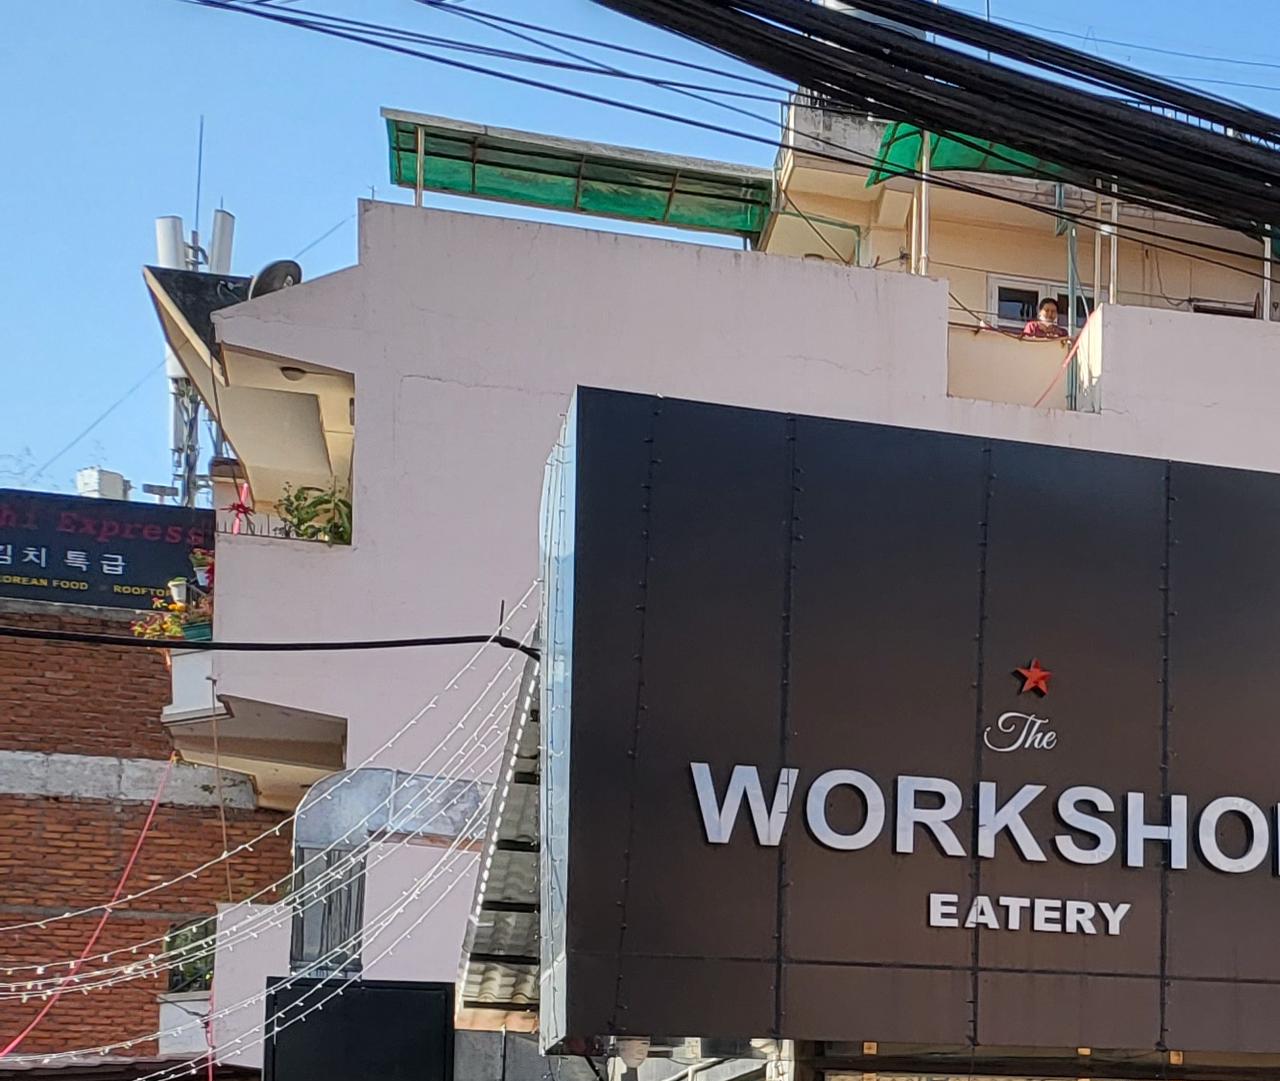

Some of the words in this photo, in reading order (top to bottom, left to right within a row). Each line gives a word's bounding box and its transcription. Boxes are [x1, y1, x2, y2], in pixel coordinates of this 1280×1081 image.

[56, 511, 206, 545] Express
[64, 550, 126, 575] 특급
[0, 575, 48, 587] OREAN
[52, 579, 89, 591] FOOD
[983, 710, 1058, 753] The
[928, 893, 1132, 936] EATERY
